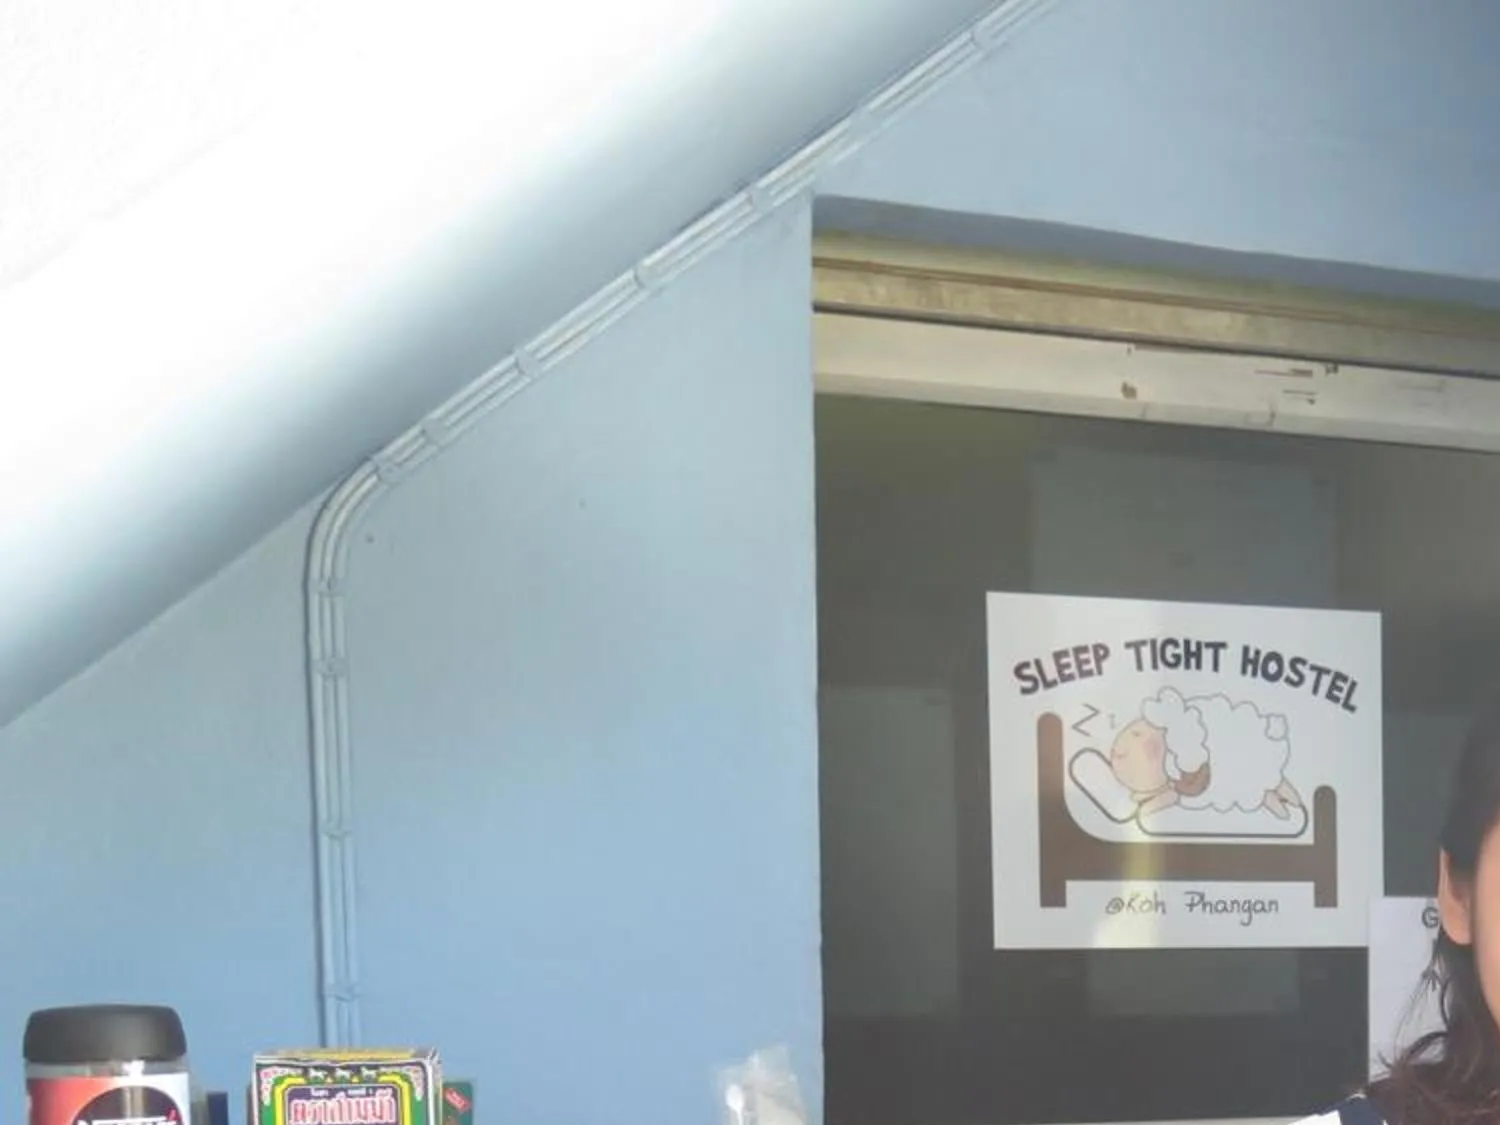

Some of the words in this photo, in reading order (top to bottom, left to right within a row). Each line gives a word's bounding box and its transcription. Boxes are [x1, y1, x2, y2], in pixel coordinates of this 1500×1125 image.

[1013, 641, 1111, 696] SLEEP
[1124, 637, 1228, 673] TIGHT
[1240, 643, 1359, 714] HOSTEL
[1184, 890, 1280, 926] Phangan
